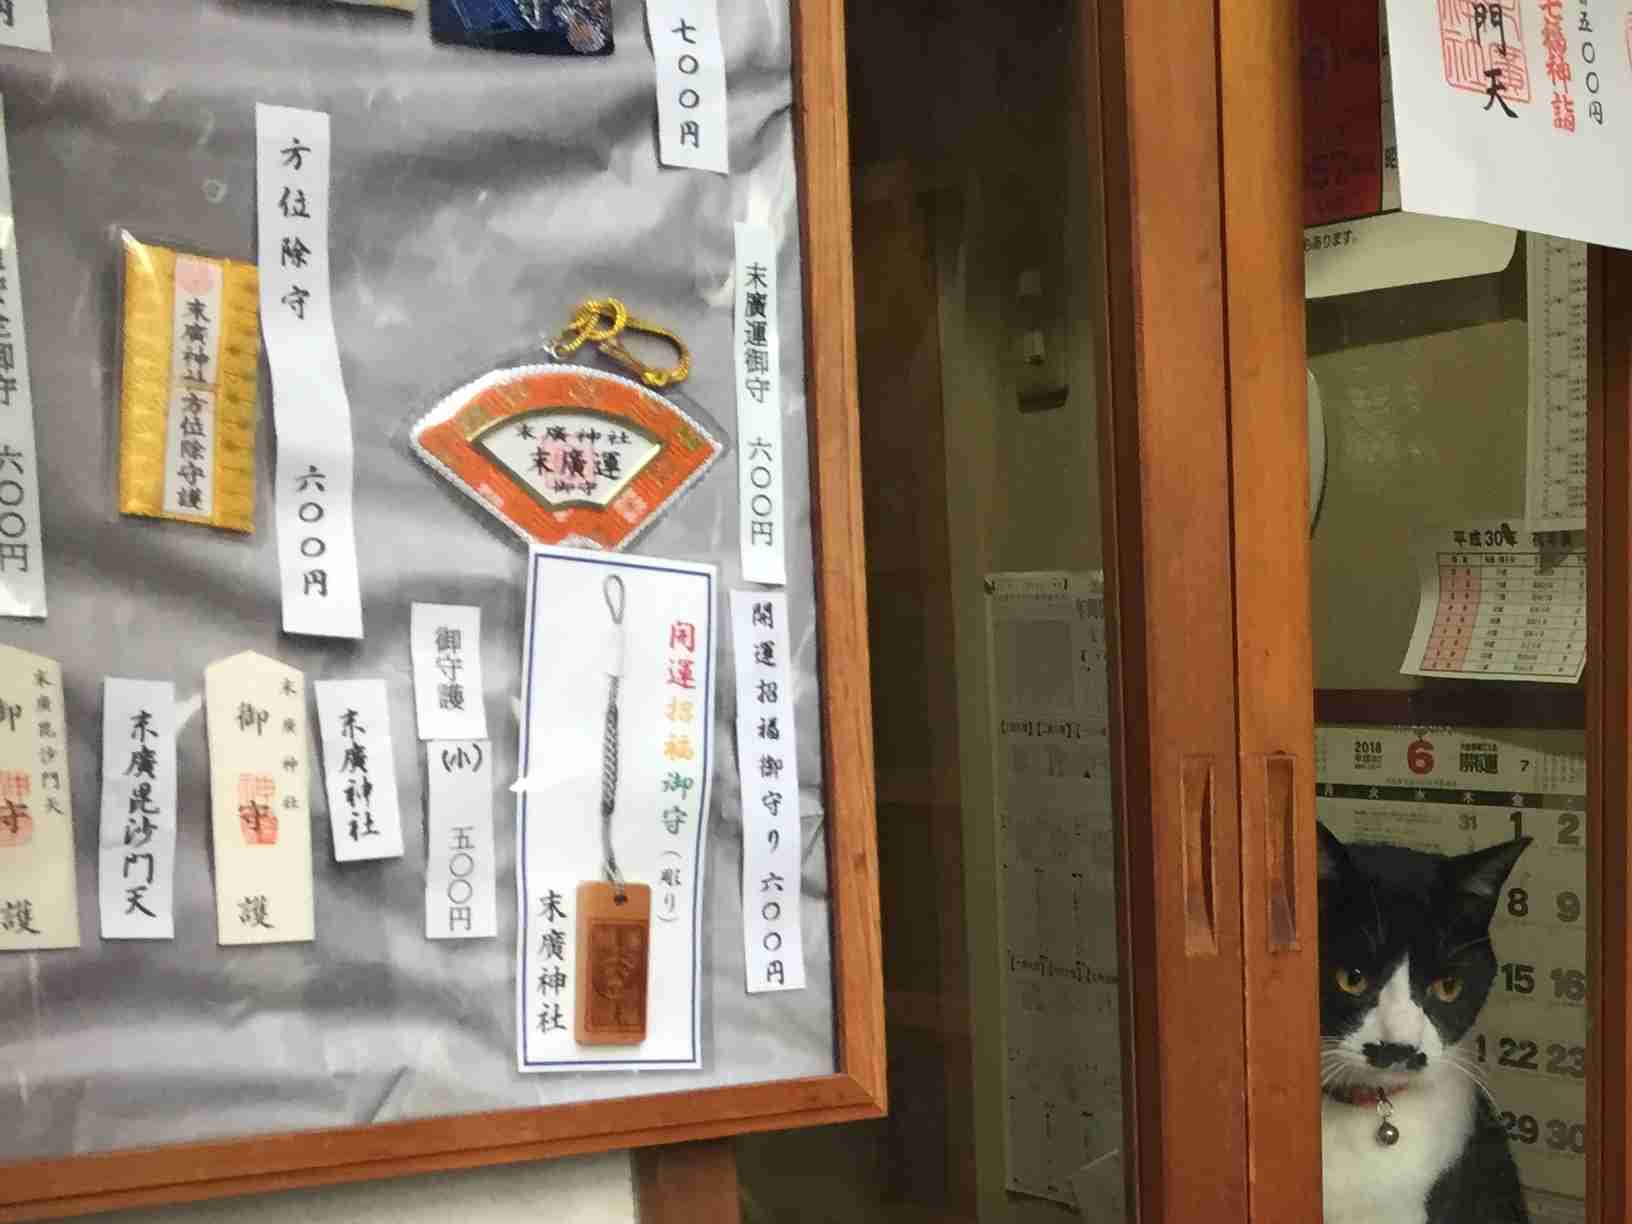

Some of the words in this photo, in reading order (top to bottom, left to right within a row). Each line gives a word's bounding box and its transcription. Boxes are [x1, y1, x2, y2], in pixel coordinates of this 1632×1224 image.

[278, 137, 312, 320] 方位除守
[1354, 741, 1383, 754] 2018
[1407, 740, 1435, 775] 6
[339, 708, 381, 840] 末廣神社
[122, 709, 160, 919] 末廣毘沙門天
[1557, 813, 1581, 846] 2
[1507, 887, 1529, 918] 8
[1556, 891, 1581, 923] 9
[536, 888, 569, 1036] 末廣神社
[1500, 962, 1535, 995] 15
[1550, 967, 1585, 1002] 16
[1498, 1036, 1540, 1072] 22
